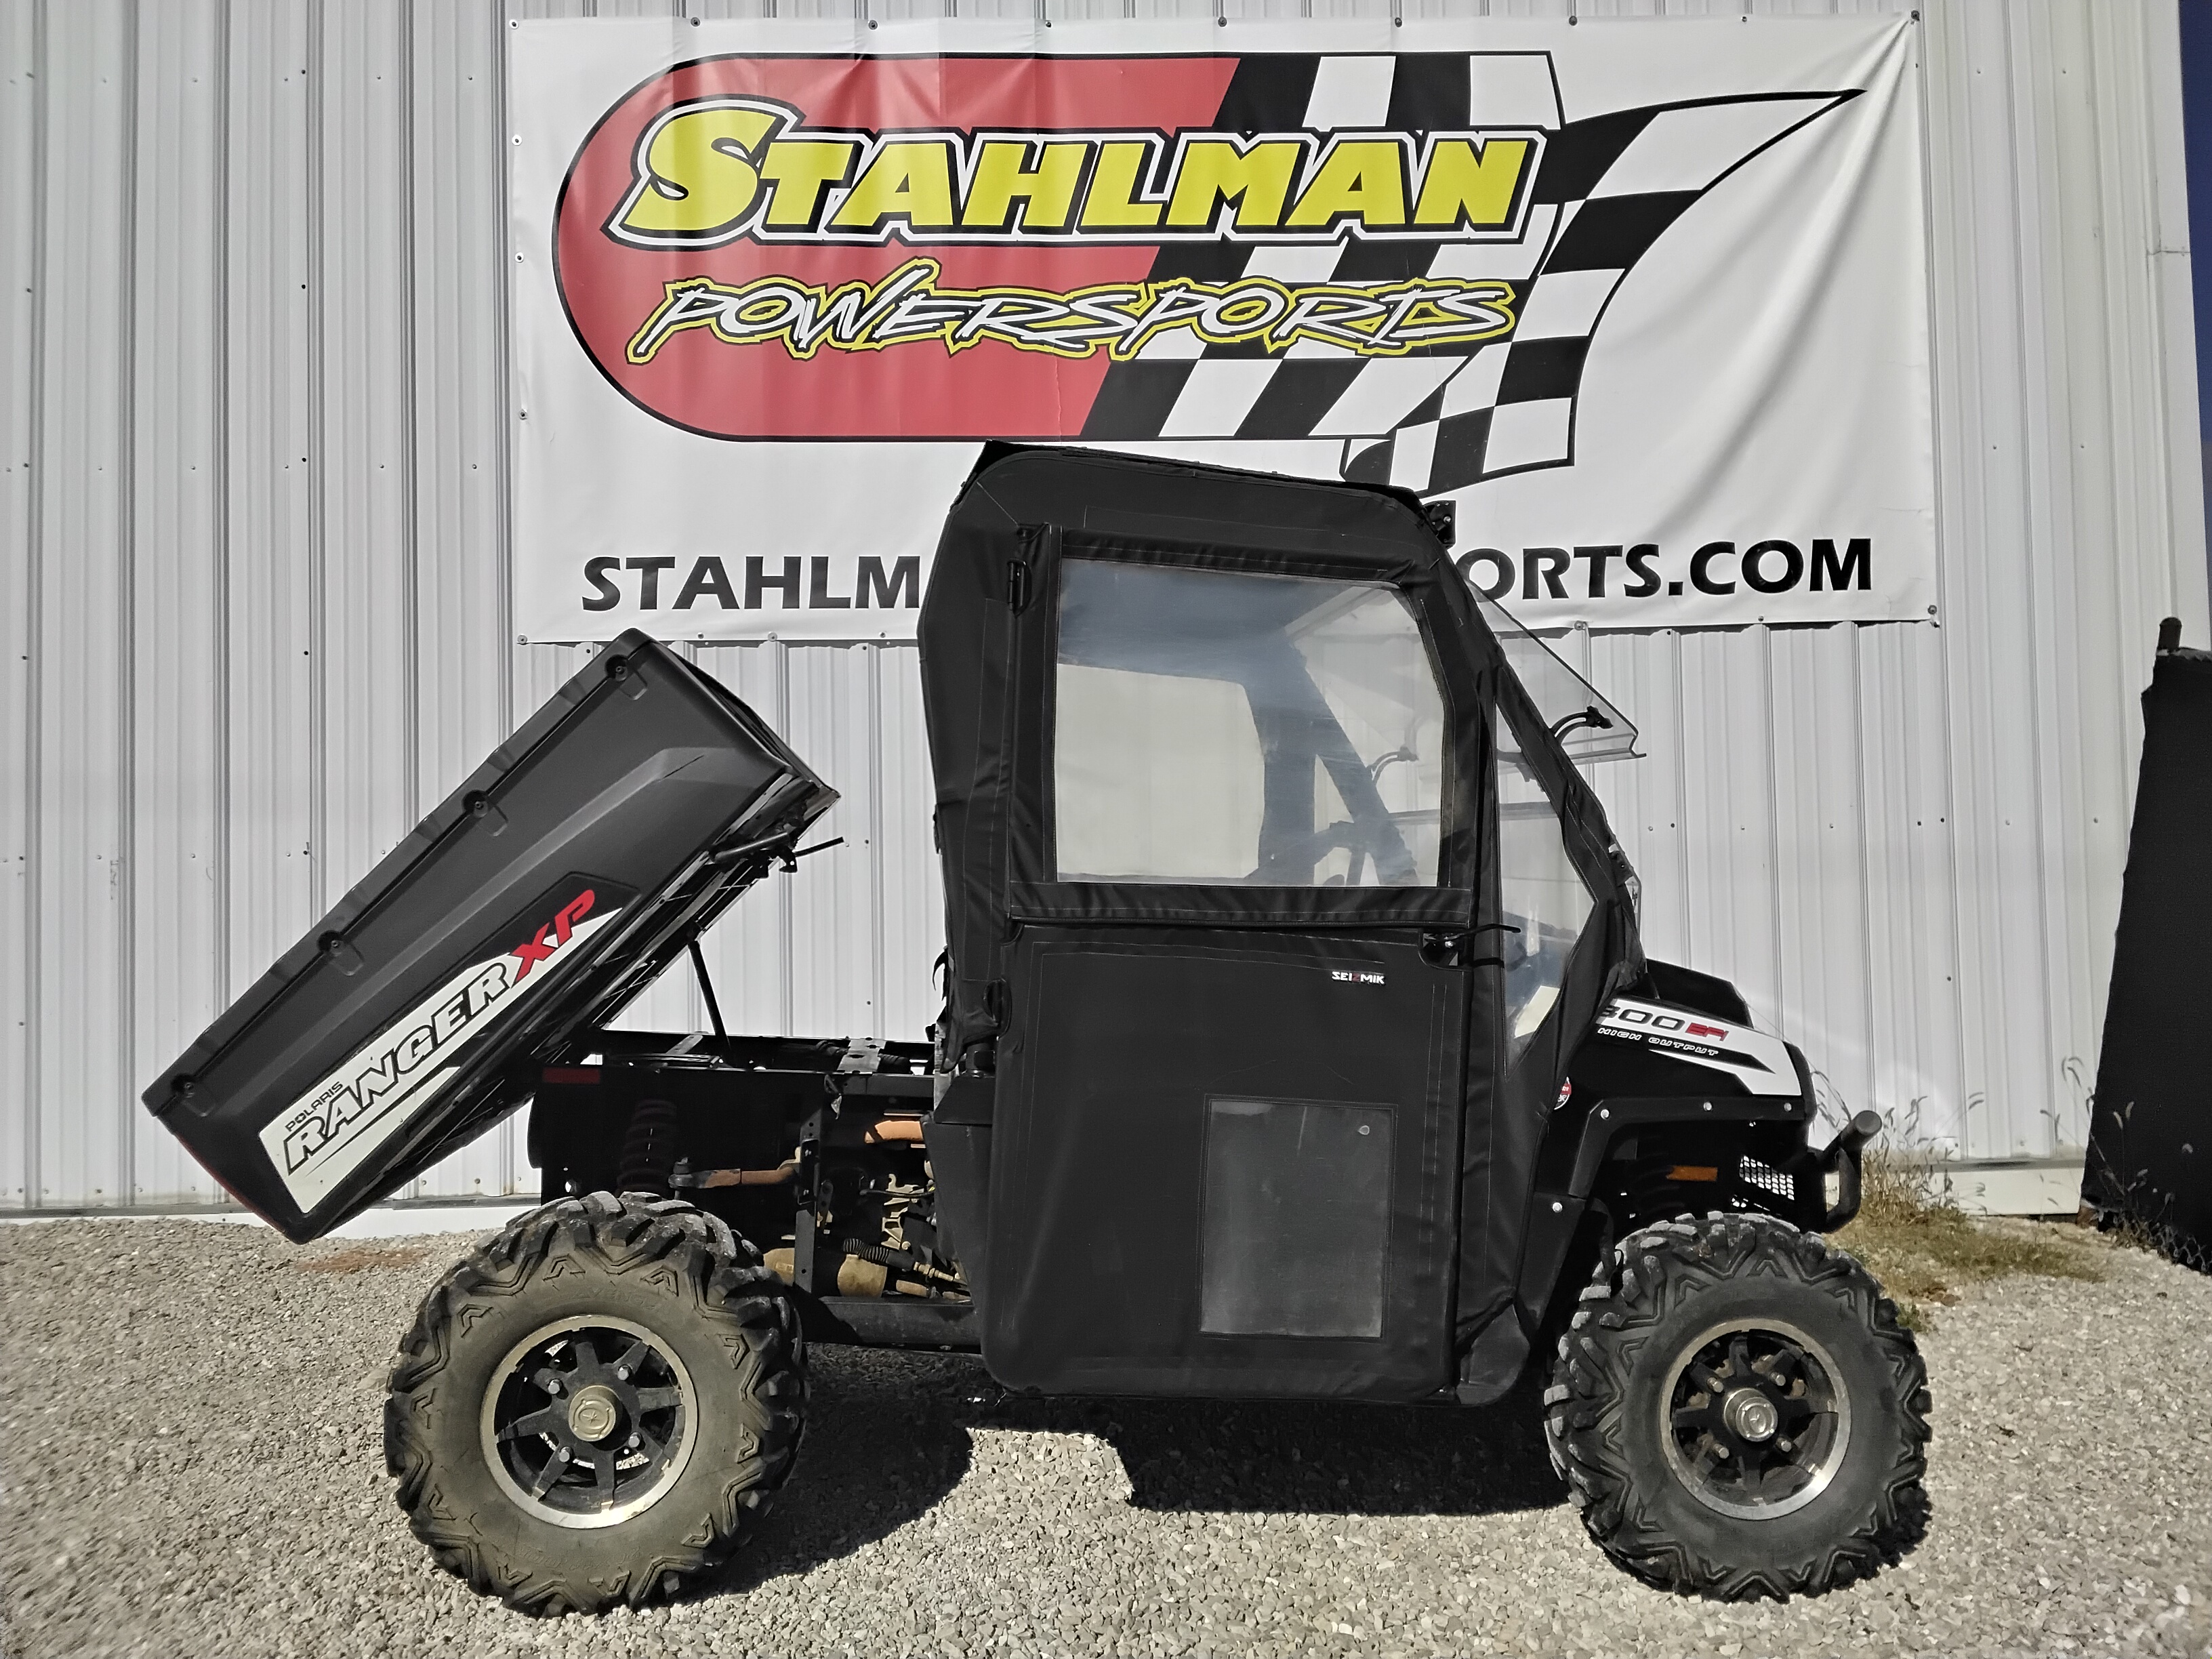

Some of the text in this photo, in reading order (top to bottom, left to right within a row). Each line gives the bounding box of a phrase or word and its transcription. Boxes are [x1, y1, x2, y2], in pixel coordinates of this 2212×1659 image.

[605, 96, 1547, 243] STAHLMAN
[628, 258, 1517, 363] POWERSPORTS
[1332, 970, 1385, 985] SEIZMIK
[283, 888, 596, 1176] RANGER XP
[1597, 1027, 1719, 1056] HIGH OUTPUT
[1685, 1021, 1729, 1042] EFI
[285, 1082, 343, 1132] POLARIS
